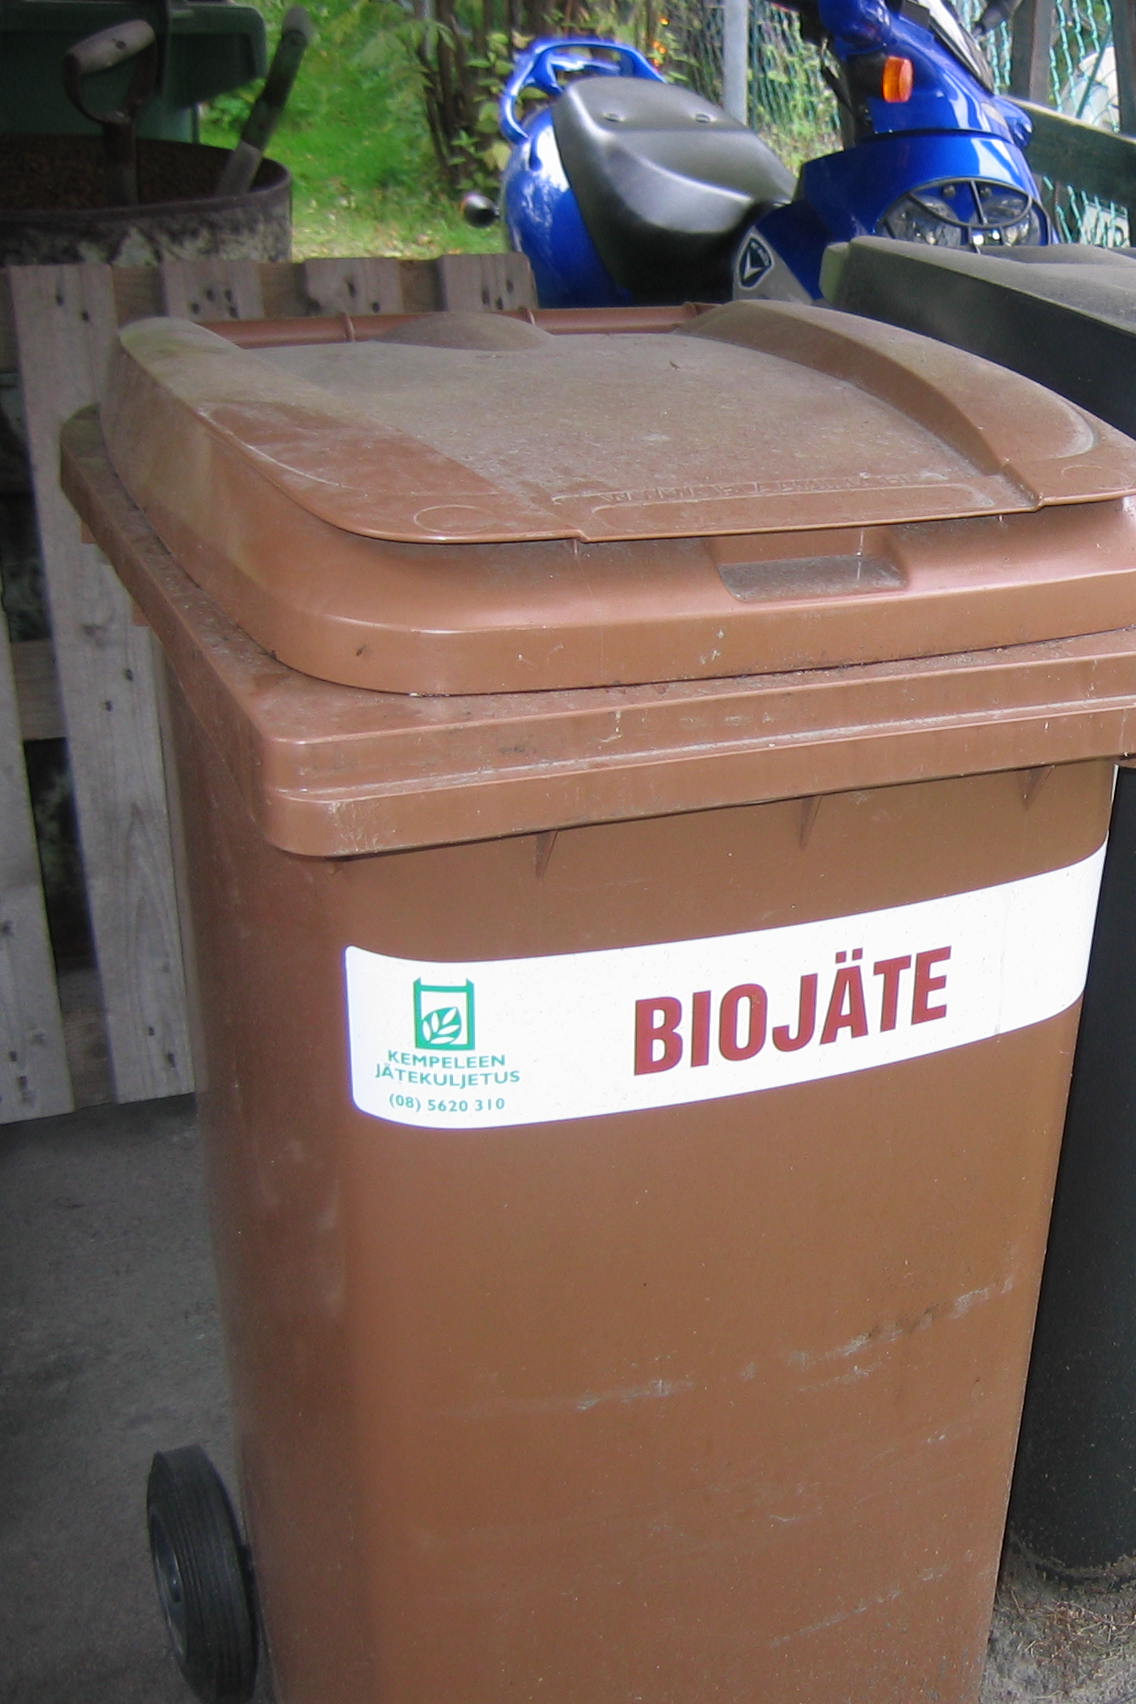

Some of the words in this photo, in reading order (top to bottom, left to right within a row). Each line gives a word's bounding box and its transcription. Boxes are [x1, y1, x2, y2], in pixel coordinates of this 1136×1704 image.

[634, 945, 951, 1076] BIOJÄTE
[388, 1049, 506, 1069] KEMPELEEN
[375, 1063, 520, 1089] JÄTEKULJETUS
[388, 1093, 421, 1112] (08)
[427, 1099, 468, 1112] 5620
[475, 1098, 505, 1111] 310
